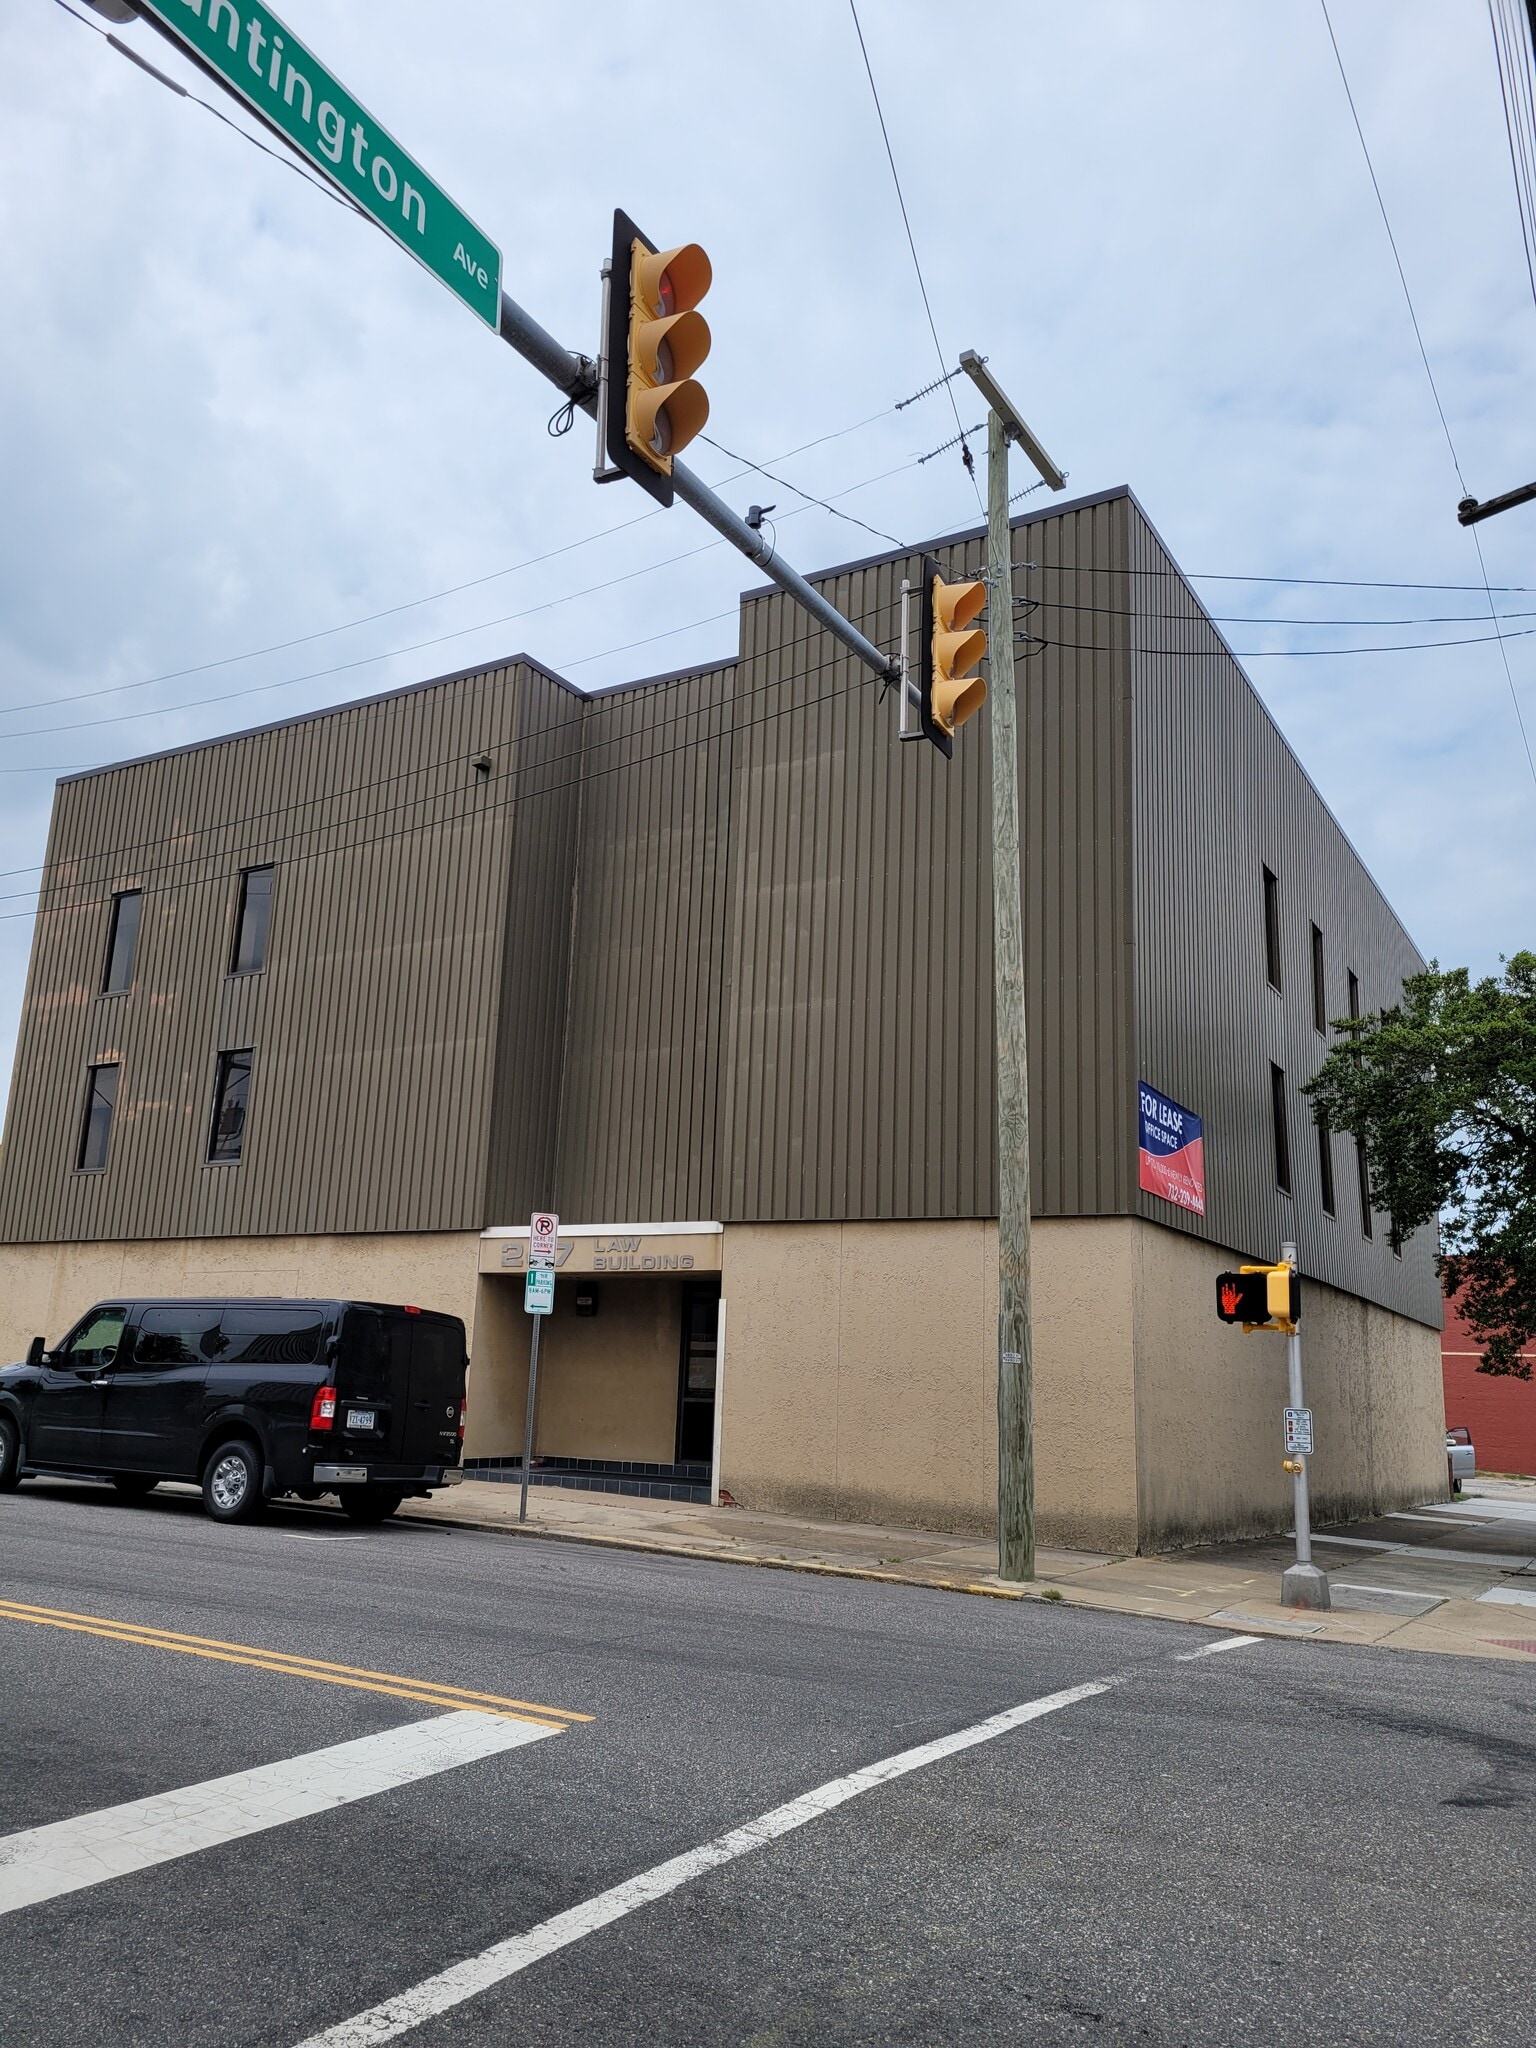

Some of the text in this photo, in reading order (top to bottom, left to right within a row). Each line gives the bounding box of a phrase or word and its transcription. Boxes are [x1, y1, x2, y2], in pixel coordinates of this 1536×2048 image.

[187, 0, 489, 290] ntington Ave
[1140, 1091, 1183, 1135] FOR LEASE
[1161, 1130, 1178, 1149] SPACE
[501, 1242, 575, 1268] 27
[594, 1237, 642, 1252] LAW
[593, 1255, 695, 1270] BUILDING
